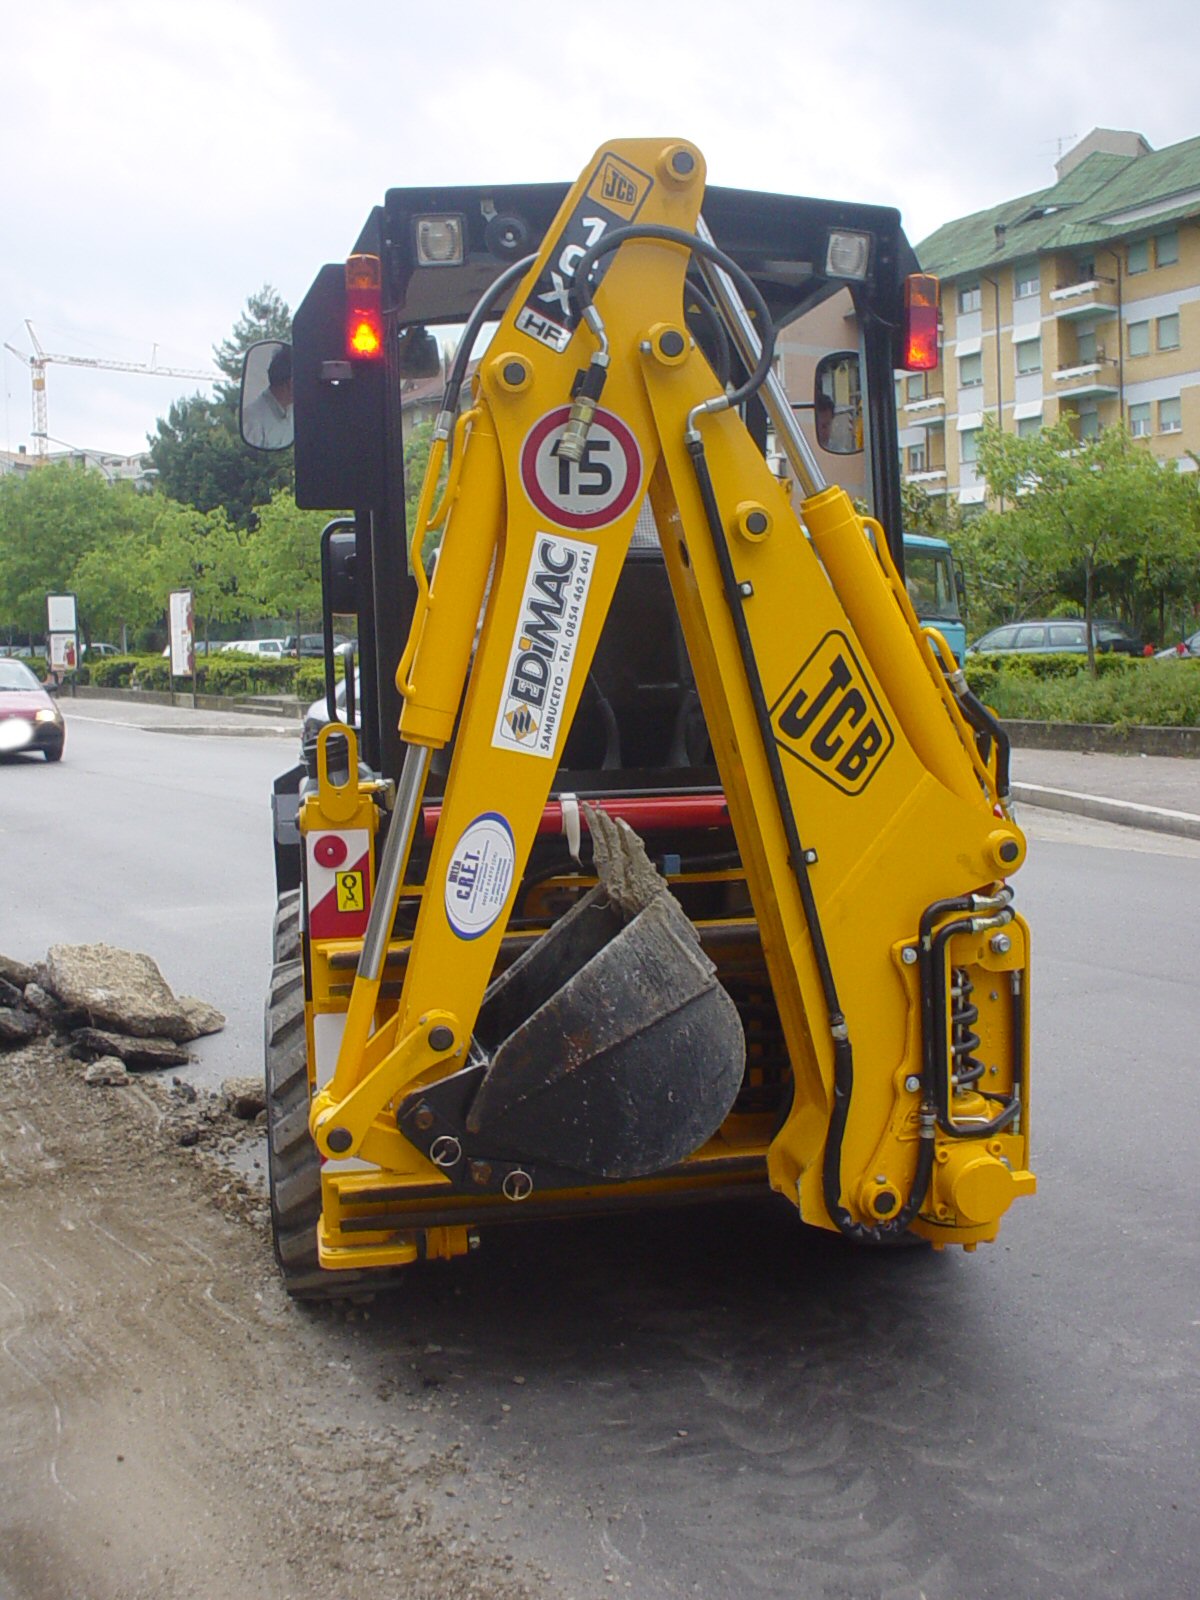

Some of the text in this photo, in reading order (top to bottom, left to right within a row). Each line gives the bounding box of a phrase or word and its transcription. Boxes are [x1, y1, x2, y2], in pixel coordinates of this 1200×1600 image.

[604, 169, 636, 204] JCB
[523, 313, 564, 342] HF
[550, 439, 613, 496] 15
[579, 549, 593, 574] 641
[573, 575, 587, 604] 462
[565, 603, 580, 639] 0854
[559, 641, 573, 665] Tel.
[540, 674, 565, 753] SAMBUCETO
[778, 653, 883, 781] JCB
